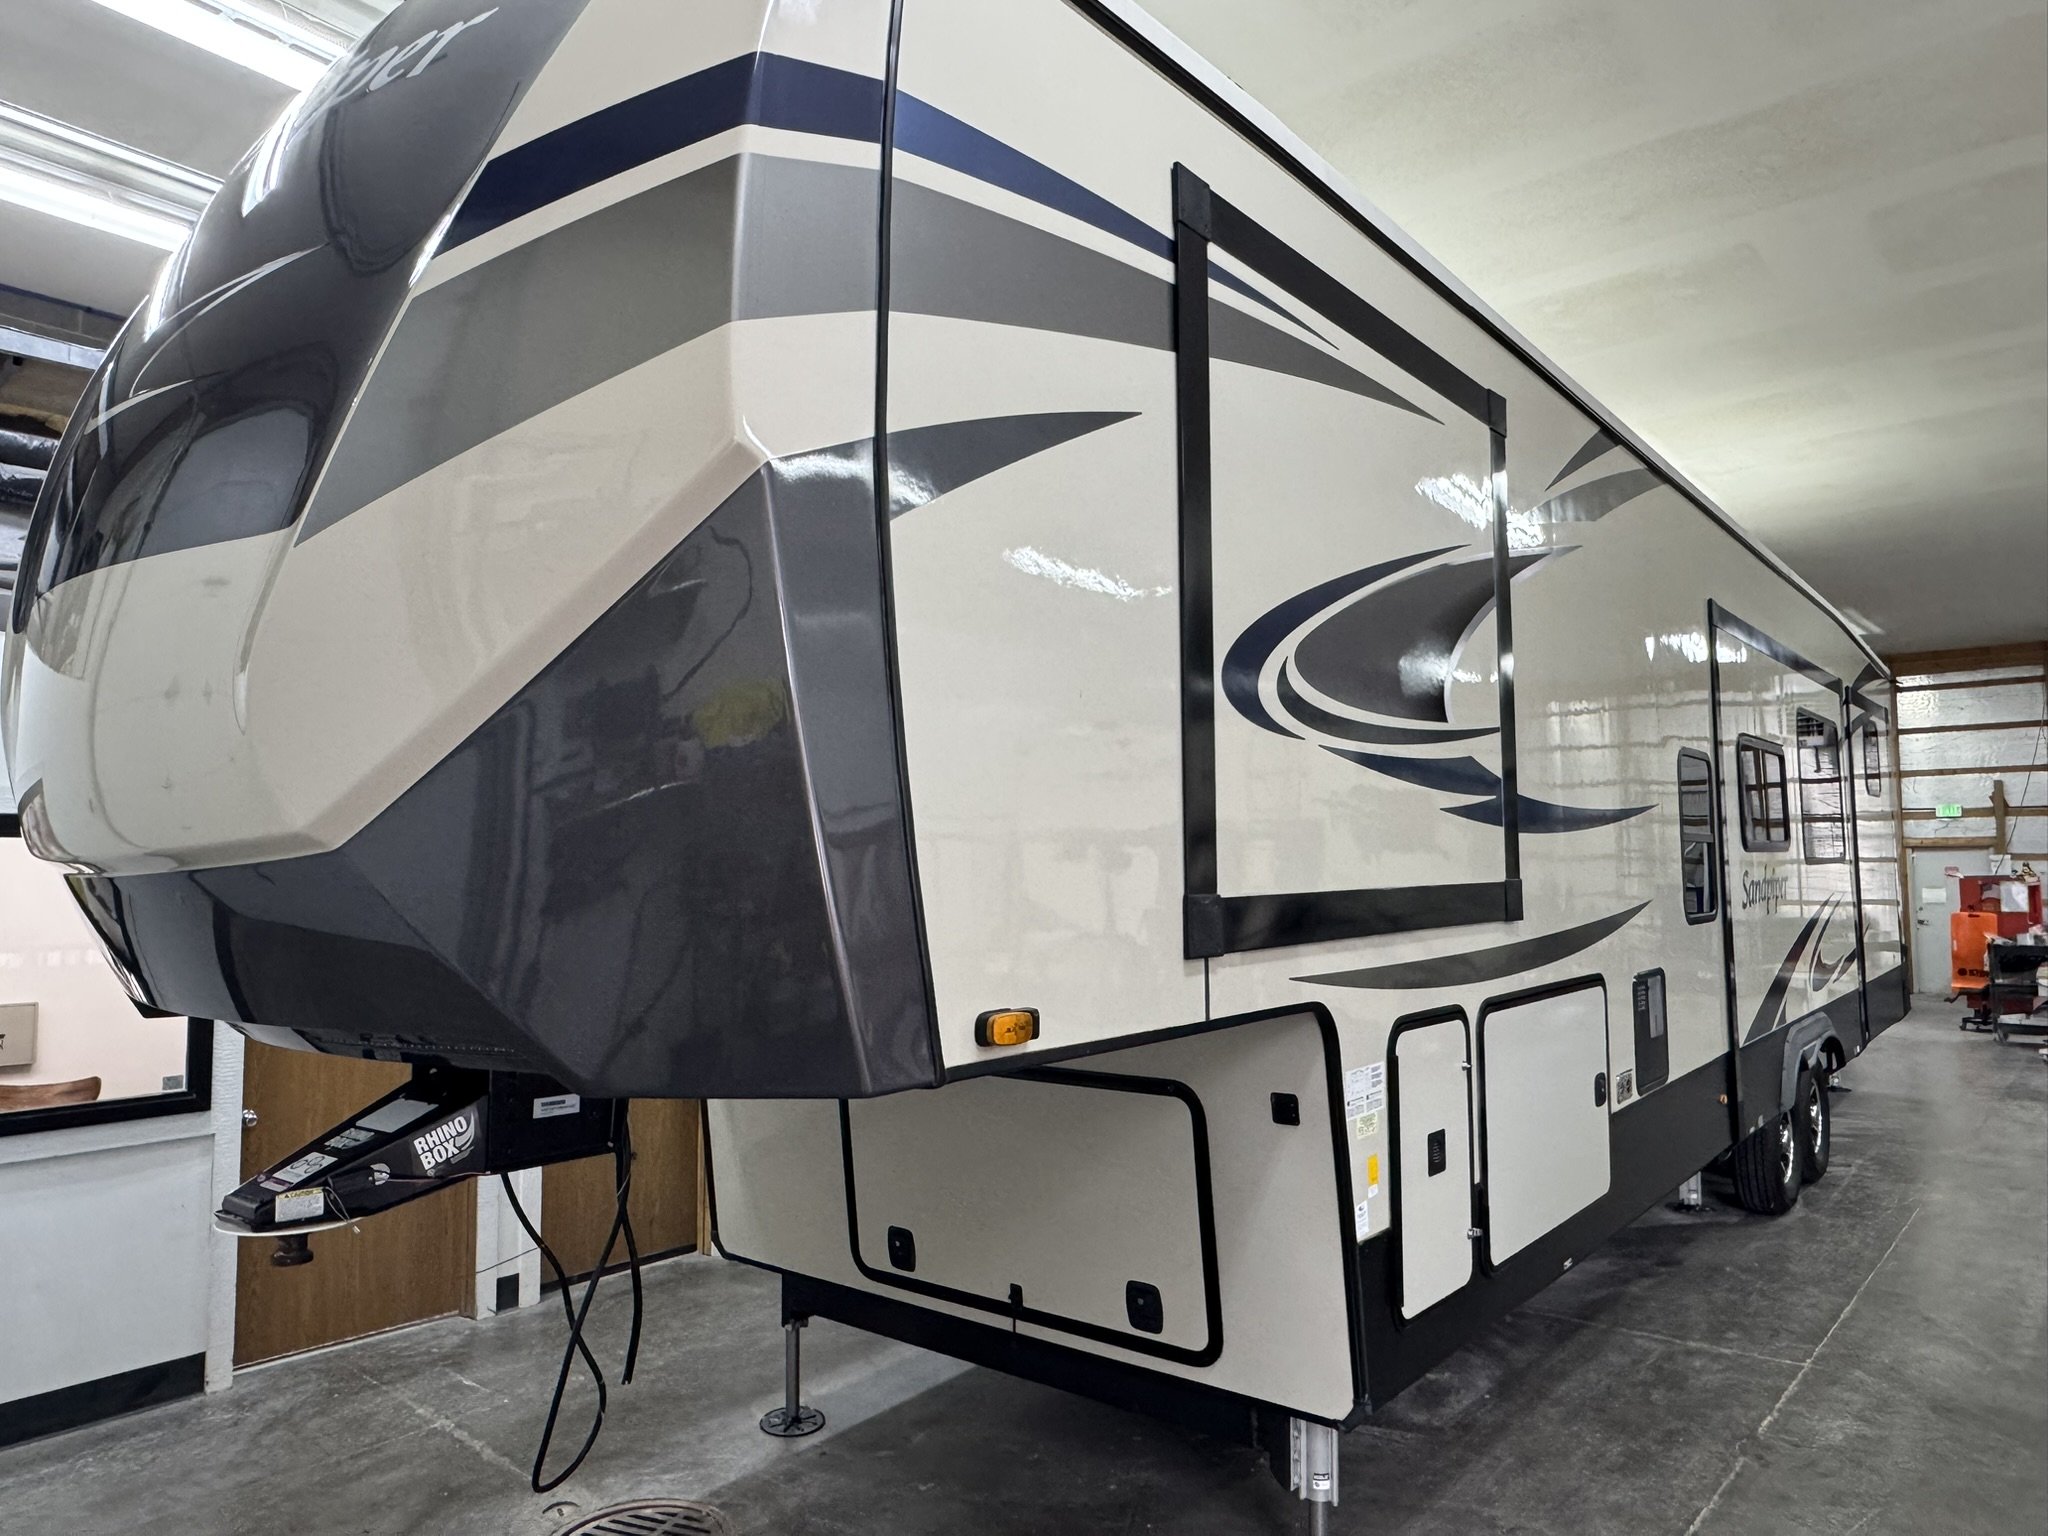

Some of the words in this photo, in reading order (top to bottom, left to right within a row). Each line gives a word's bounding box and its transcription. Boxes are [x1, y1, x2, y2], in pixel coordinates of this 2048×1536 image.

[1742, 864, 1788, 915] Sandpiper
[413, 1116, 468, 1155] RHINO
[420, 1138, 460, 1170] BOX
